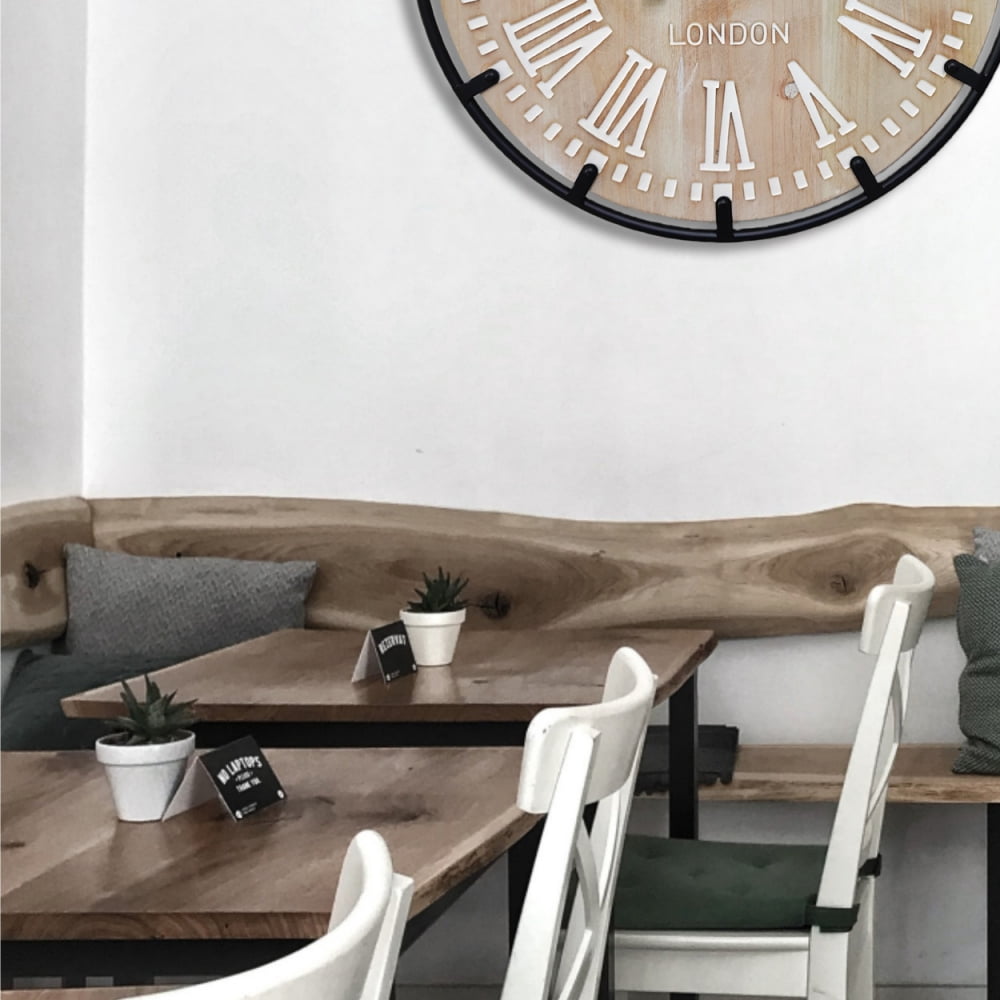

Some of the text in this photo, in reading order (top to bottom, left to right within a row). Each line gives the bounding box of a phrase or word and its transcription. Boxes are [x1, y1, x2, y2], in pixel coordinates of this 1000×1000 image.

[669, 22, 789, 46] LONDON
[577, 48, 668, 158] VII
[699, 79, 756, 172] VI
[787, 60, 858, 149] V
[217, 756, 263, 785] NO LAPTOPS
